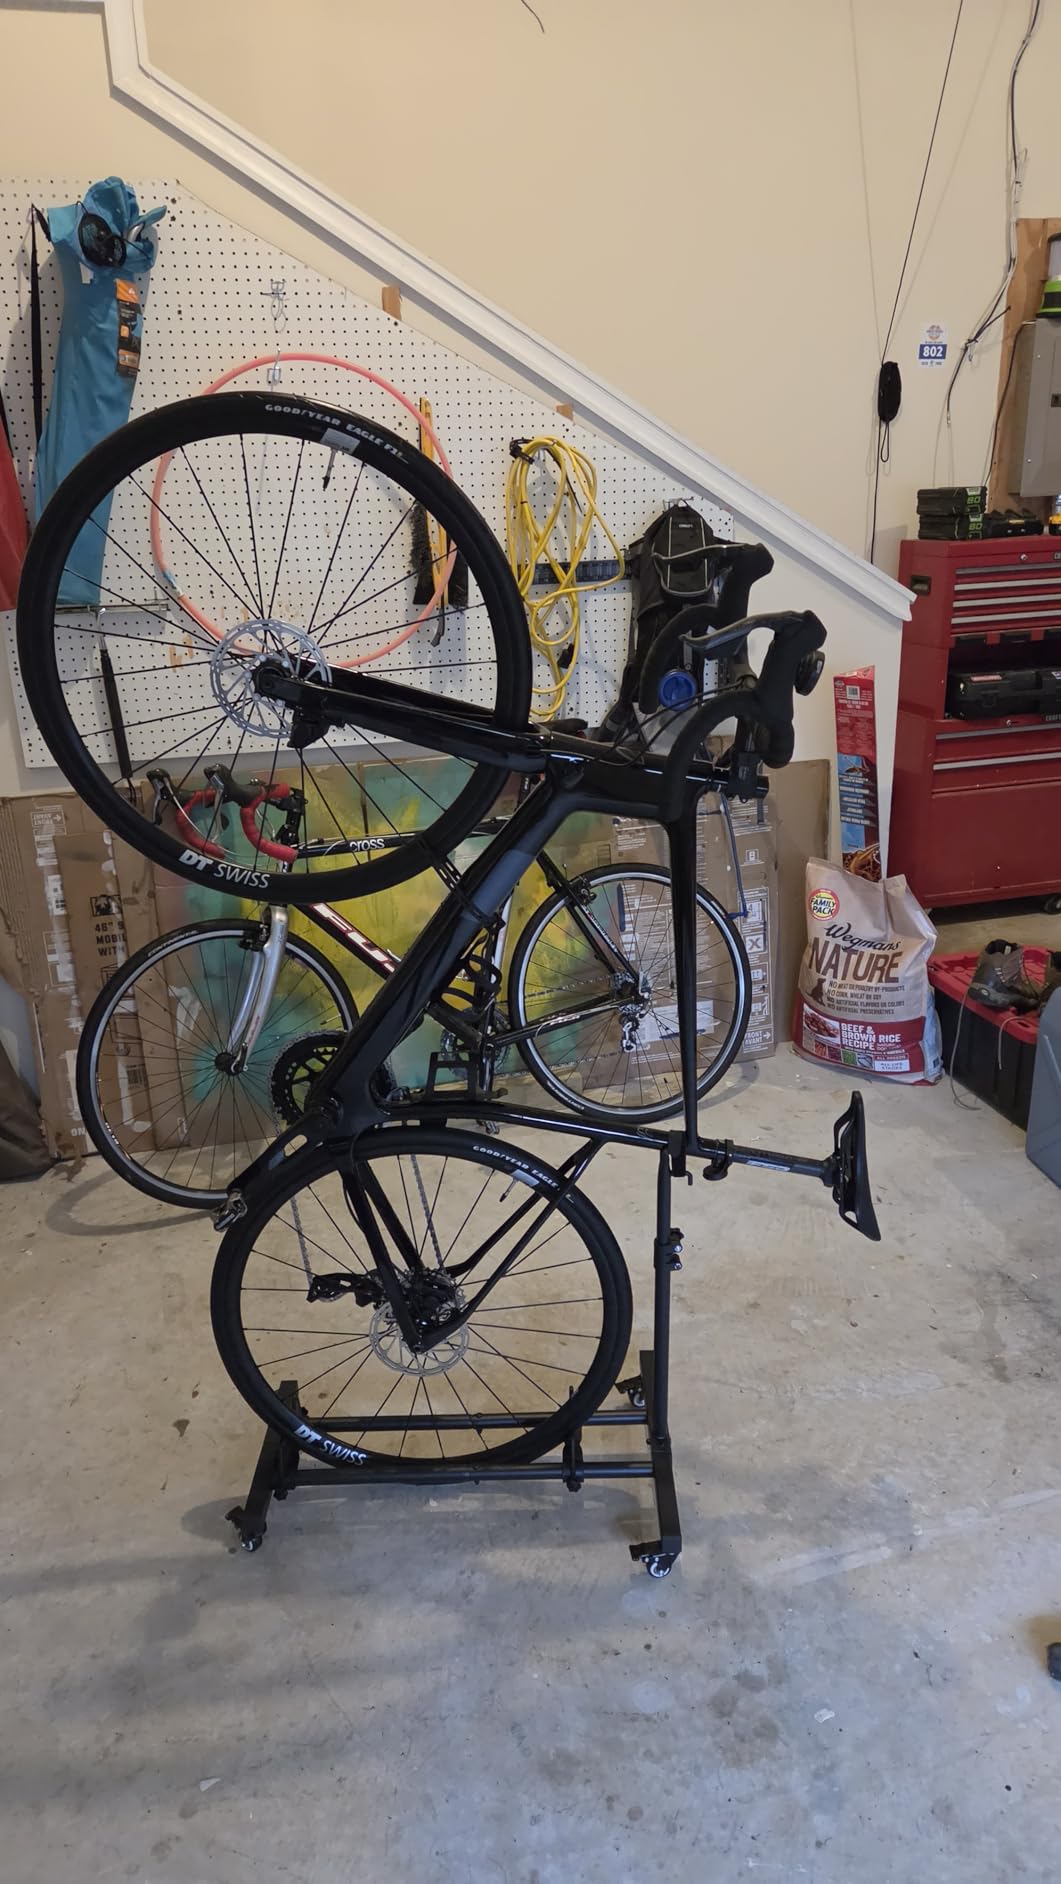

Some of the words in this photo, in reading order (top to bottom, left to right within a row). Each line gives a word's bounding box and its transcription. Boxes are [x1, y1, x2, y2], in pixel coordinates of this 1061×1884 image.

[922, 345, 944, 357] 802
[345, 423, 384, 446] EAGLE
[350, 838, 385, 852] cross
[179, 849, 214, 871] DT
[213, 863, 271, 889] SWISS
[810, 897, 836, 908] FAMILY
[812, 905, 834, 915] PACK
[824, 922, 902, 951] Wegmans
[809, 937, 903, 984] NATURE
[841, 1023, 864, 1033] BEEF
[866, 1026, 875, 1034] &
[841, 1032, 876, 1042] BROWN
[879, 1034, 902, 1043] RICE
[842, 1038, 875, 1050] RECIPE
[532, 1169, 559, 1188] EAGLE
[294, 1424, 322, 1443] DT
[321, 1440, 367, 1466] SWISS
